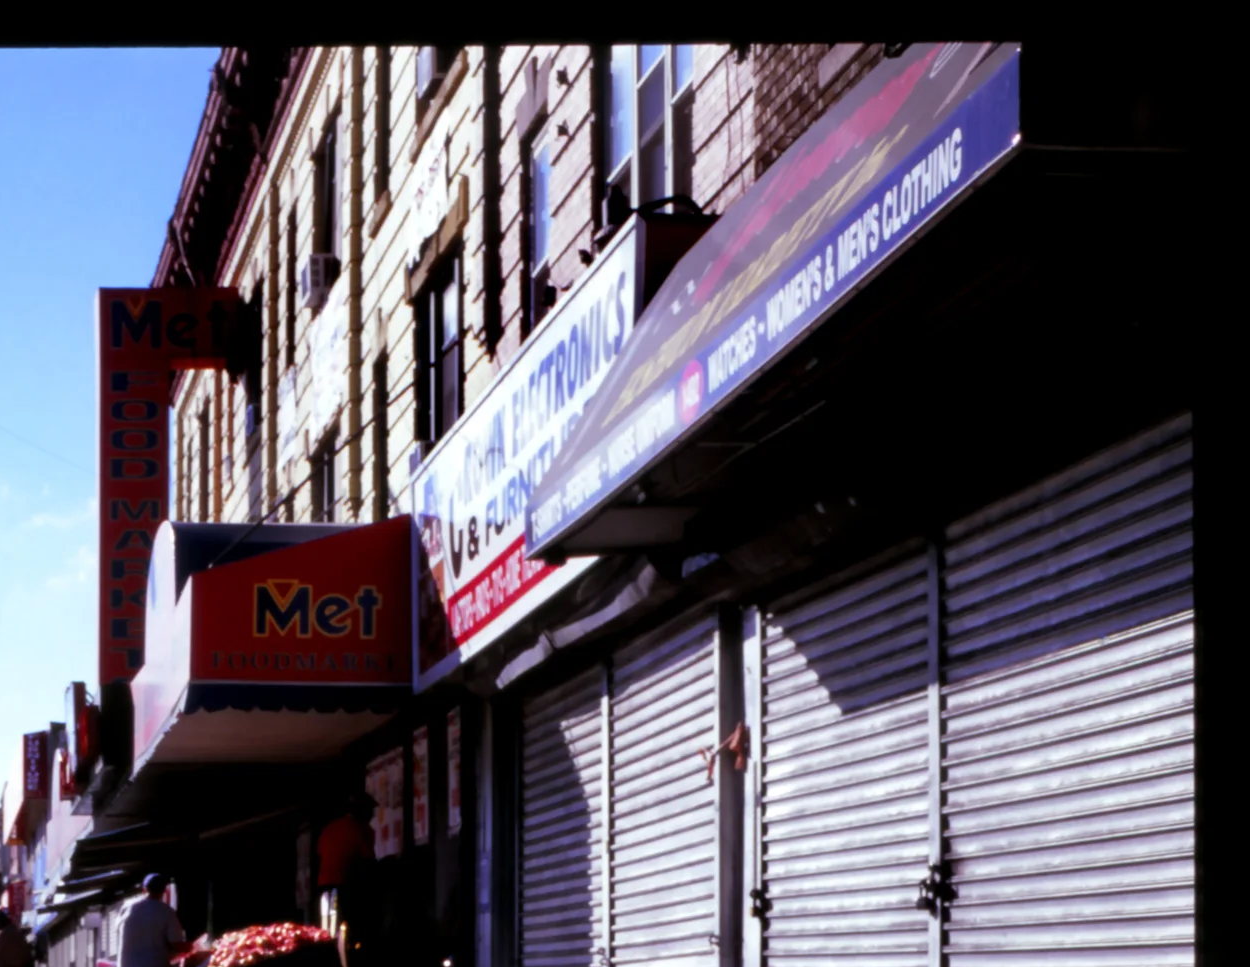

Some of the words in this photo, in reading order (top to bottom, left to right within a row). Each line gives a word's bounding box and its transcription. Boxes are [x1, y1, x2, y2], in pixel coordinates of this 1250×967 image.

[707, 314, 757, 394] WATCHES
[765, 254, 823, 341] WOMEN'S
[824, 243, 836, 292] &
[837, 201, 880, 282] MEN'S
[881, 127, 963, 241] CLOTHING
[110, 296, 228, 350] Met
[511, 270, 627, 459] ELECTRONICS
[109, 370, 160, 482] FOOD
[467, 515, 480, 561] &
[252, 577, 384, 641] Met
[209, 649, 406, 674] FOODMARK
